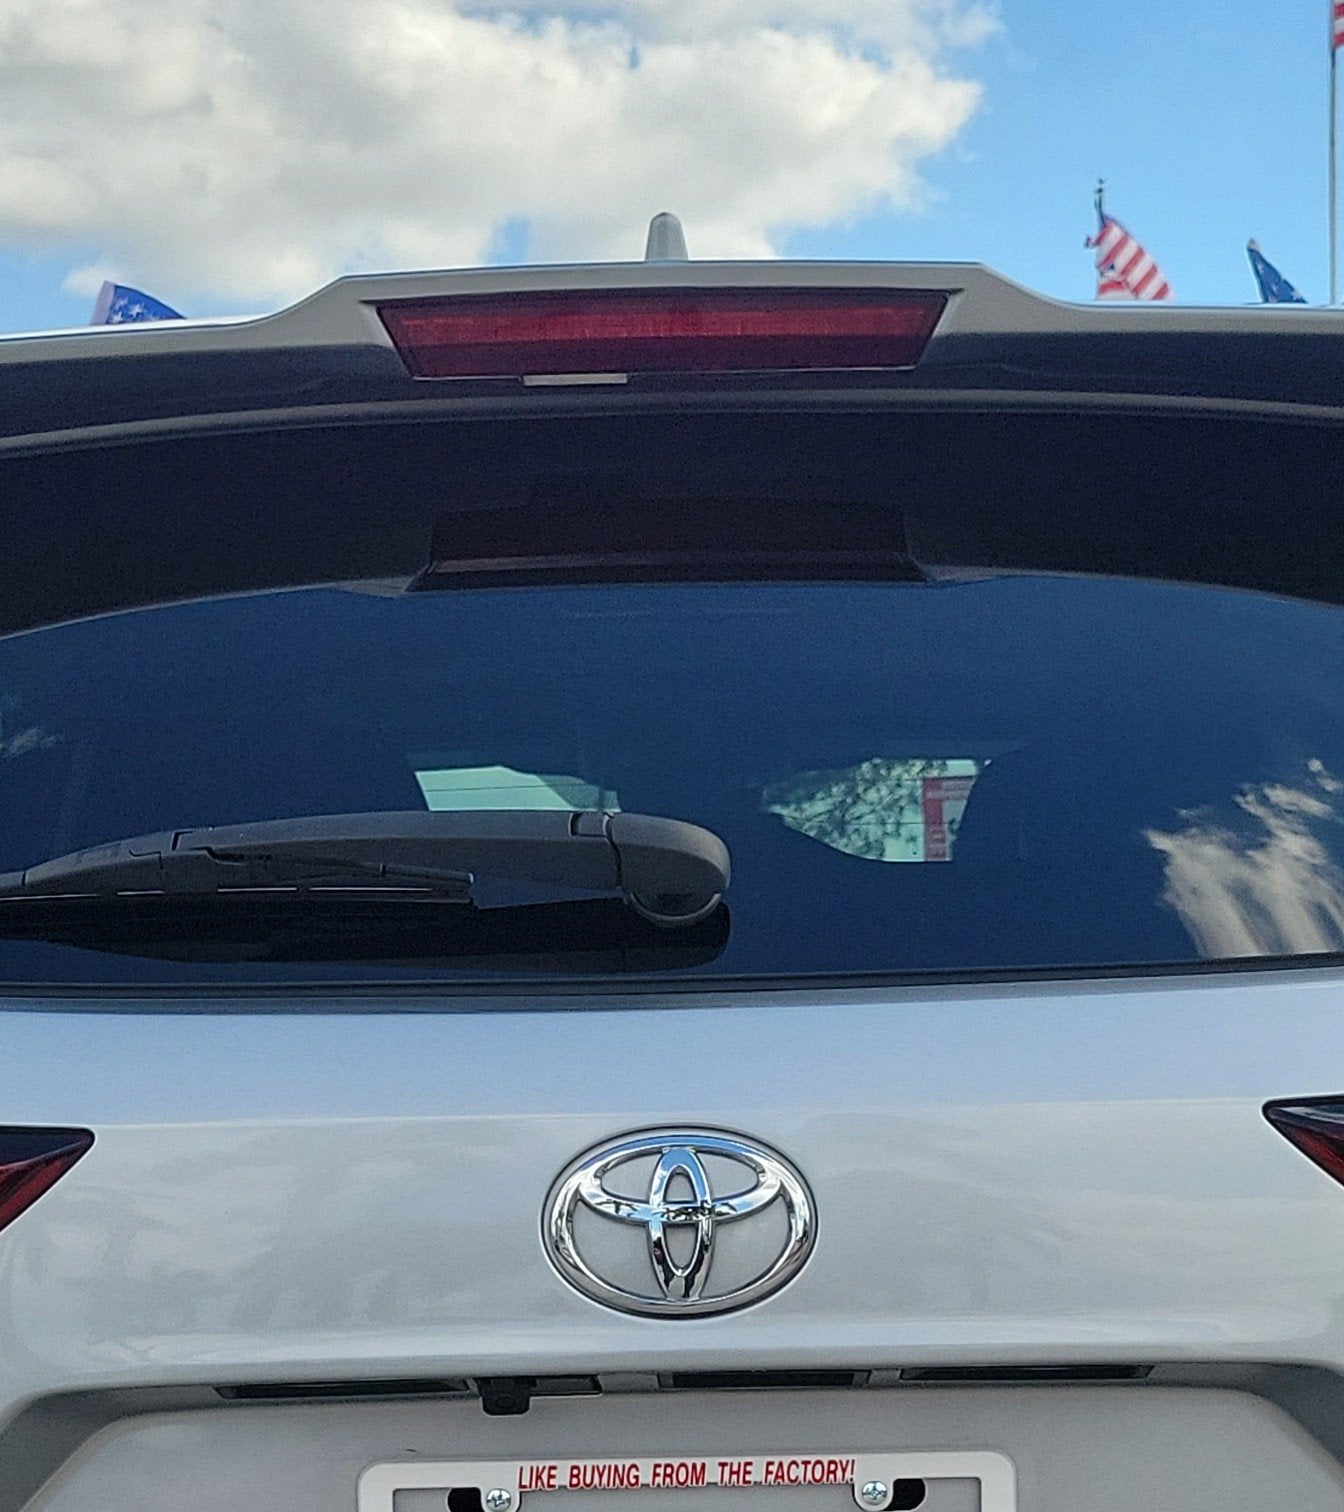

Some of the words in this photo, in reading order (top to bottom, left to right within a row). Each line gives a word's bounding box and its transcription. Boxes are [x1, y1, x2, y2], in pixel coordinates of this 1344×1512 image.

[518, 1465, 558, 1490] LIKE
[568, 1463, 641, 1489] BUYING
[650, 1461, 707, 1488] FROM
[718, 1460, 754, 1487] THE
[763, 1458, 856, 1485] FACTORY!
